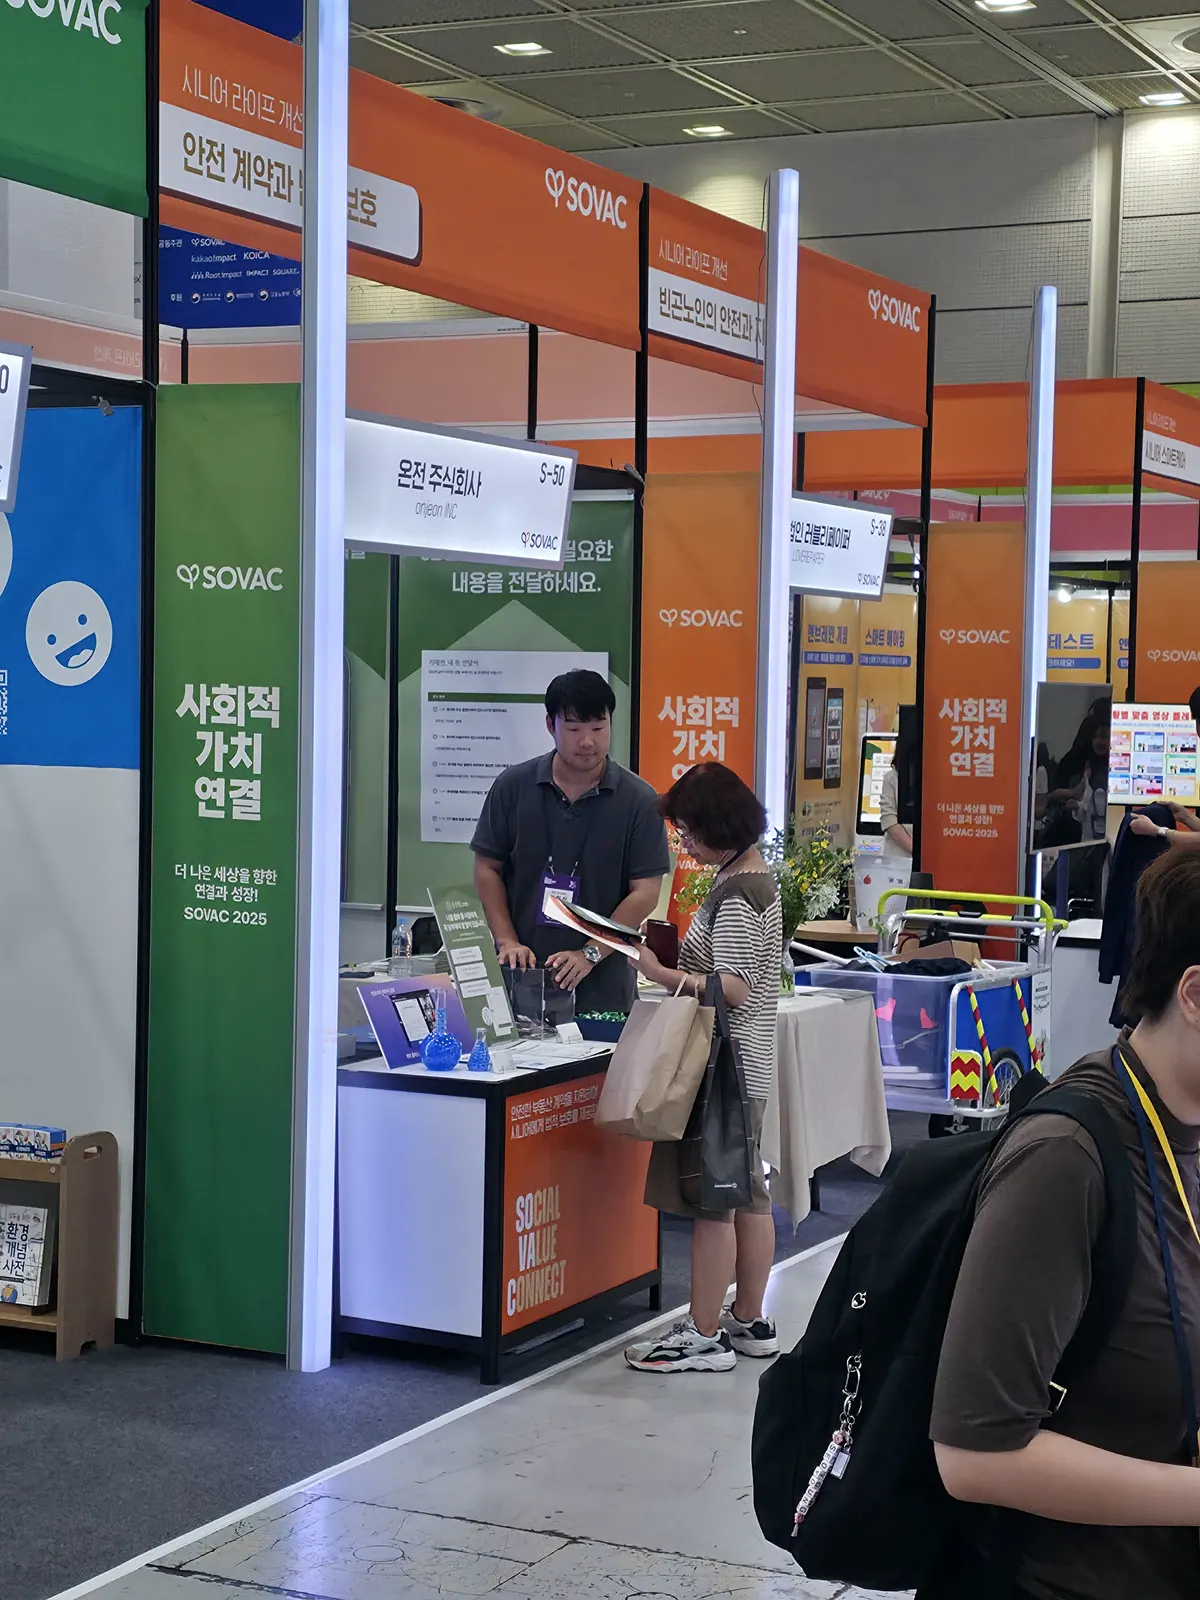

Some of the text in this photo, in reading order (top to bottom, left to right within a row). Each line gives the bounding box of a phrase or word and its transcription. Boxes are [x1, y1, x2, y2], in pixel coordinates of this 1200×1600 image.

[6, 0, 122, 45] VAC
[182, 64, 228, 108] 시니어
[232, 83, 276, 123] 라이프
[183, 132, 226, 183] 안전
[232, 147, 294, 203] 계약과
[567, 177, 628, 229] SOVAC
[243, 251, 270, 260] KOICA
[659, 238, 728, 281] 시니어 라이프 개선
[660, 286, 717, 331] 빈곤노인의
[720, 306, 752, 342] 안전과
[881, 293, 921, 333] SOVAC
[397, 459, 482, 498] 온전 주식회사
[539, 462, 565, 487] S-50
[415, 500, 458, 519] onjeon INC
[870, 519, 887, 537] S-38
[530, 533, 558, 550] SOVAC
[202, 566, 284, 591] SOVAC
[452, 571, 602, 594] 내용을 전달하세요.
[680, 609, 743, 627] SOVAC
[957, 630, 1010, 644] SOVAC
[175, 684, 280, 728] 사회적
[658, 695, 739, 728] 사회적
[938, 698, 1007, 724] 사회적
[672, 730, 725, 761] 가치
[951, 726, 995, 750] 가치
[195, 731, 262, 774] 가치
[949, 752, 995, 777] 연결
[194, 776, 261, 821] 연결
[943, 827, 974, 837] SOVAC
[175, 864, 278, 886] 더 나은 세상을 향한
[194, 883, 258, 903] 연결과 성장!
[183, 906, 267, 926] SOVAC 2025
[532, 1095, 553, 1114] 부동산
[515, 1184, 561, 1233] SOCIAL
[6, 1222, 29, 1241] 환경
[5, 1241, 27, 1260] 개념
[518, 1225, 557, 1272] VALUE
[3, 1259, 25, 1277] 사전
[507, 1259, 566, 1317] CONNECT
